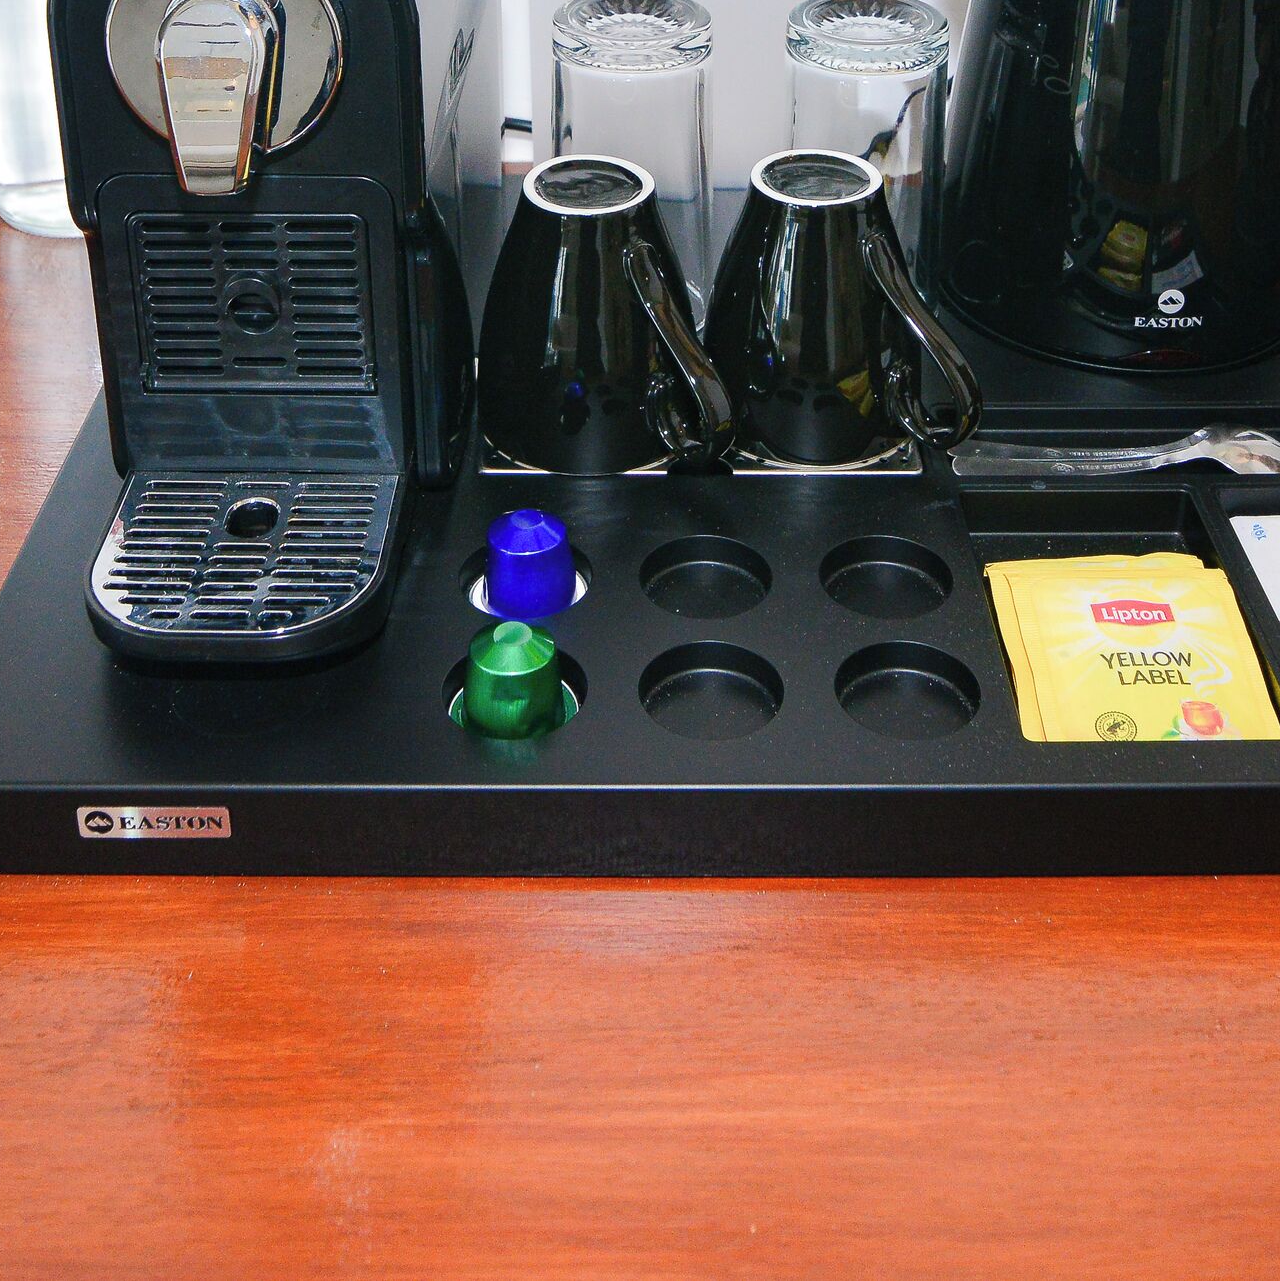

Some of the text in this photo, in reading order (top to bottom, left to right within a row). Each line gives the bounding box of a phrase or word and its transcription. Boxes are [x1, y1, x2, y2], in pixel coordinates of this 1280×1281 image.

[1134, 316, 1203, 328] EASTON
[1100, 607, 1167, 623] Lipton
[1100, 651, 1192, 669] YELLOW
[1117, 669, 1192, 686] LABEL
[119, 816, 223, 830] EASTON
